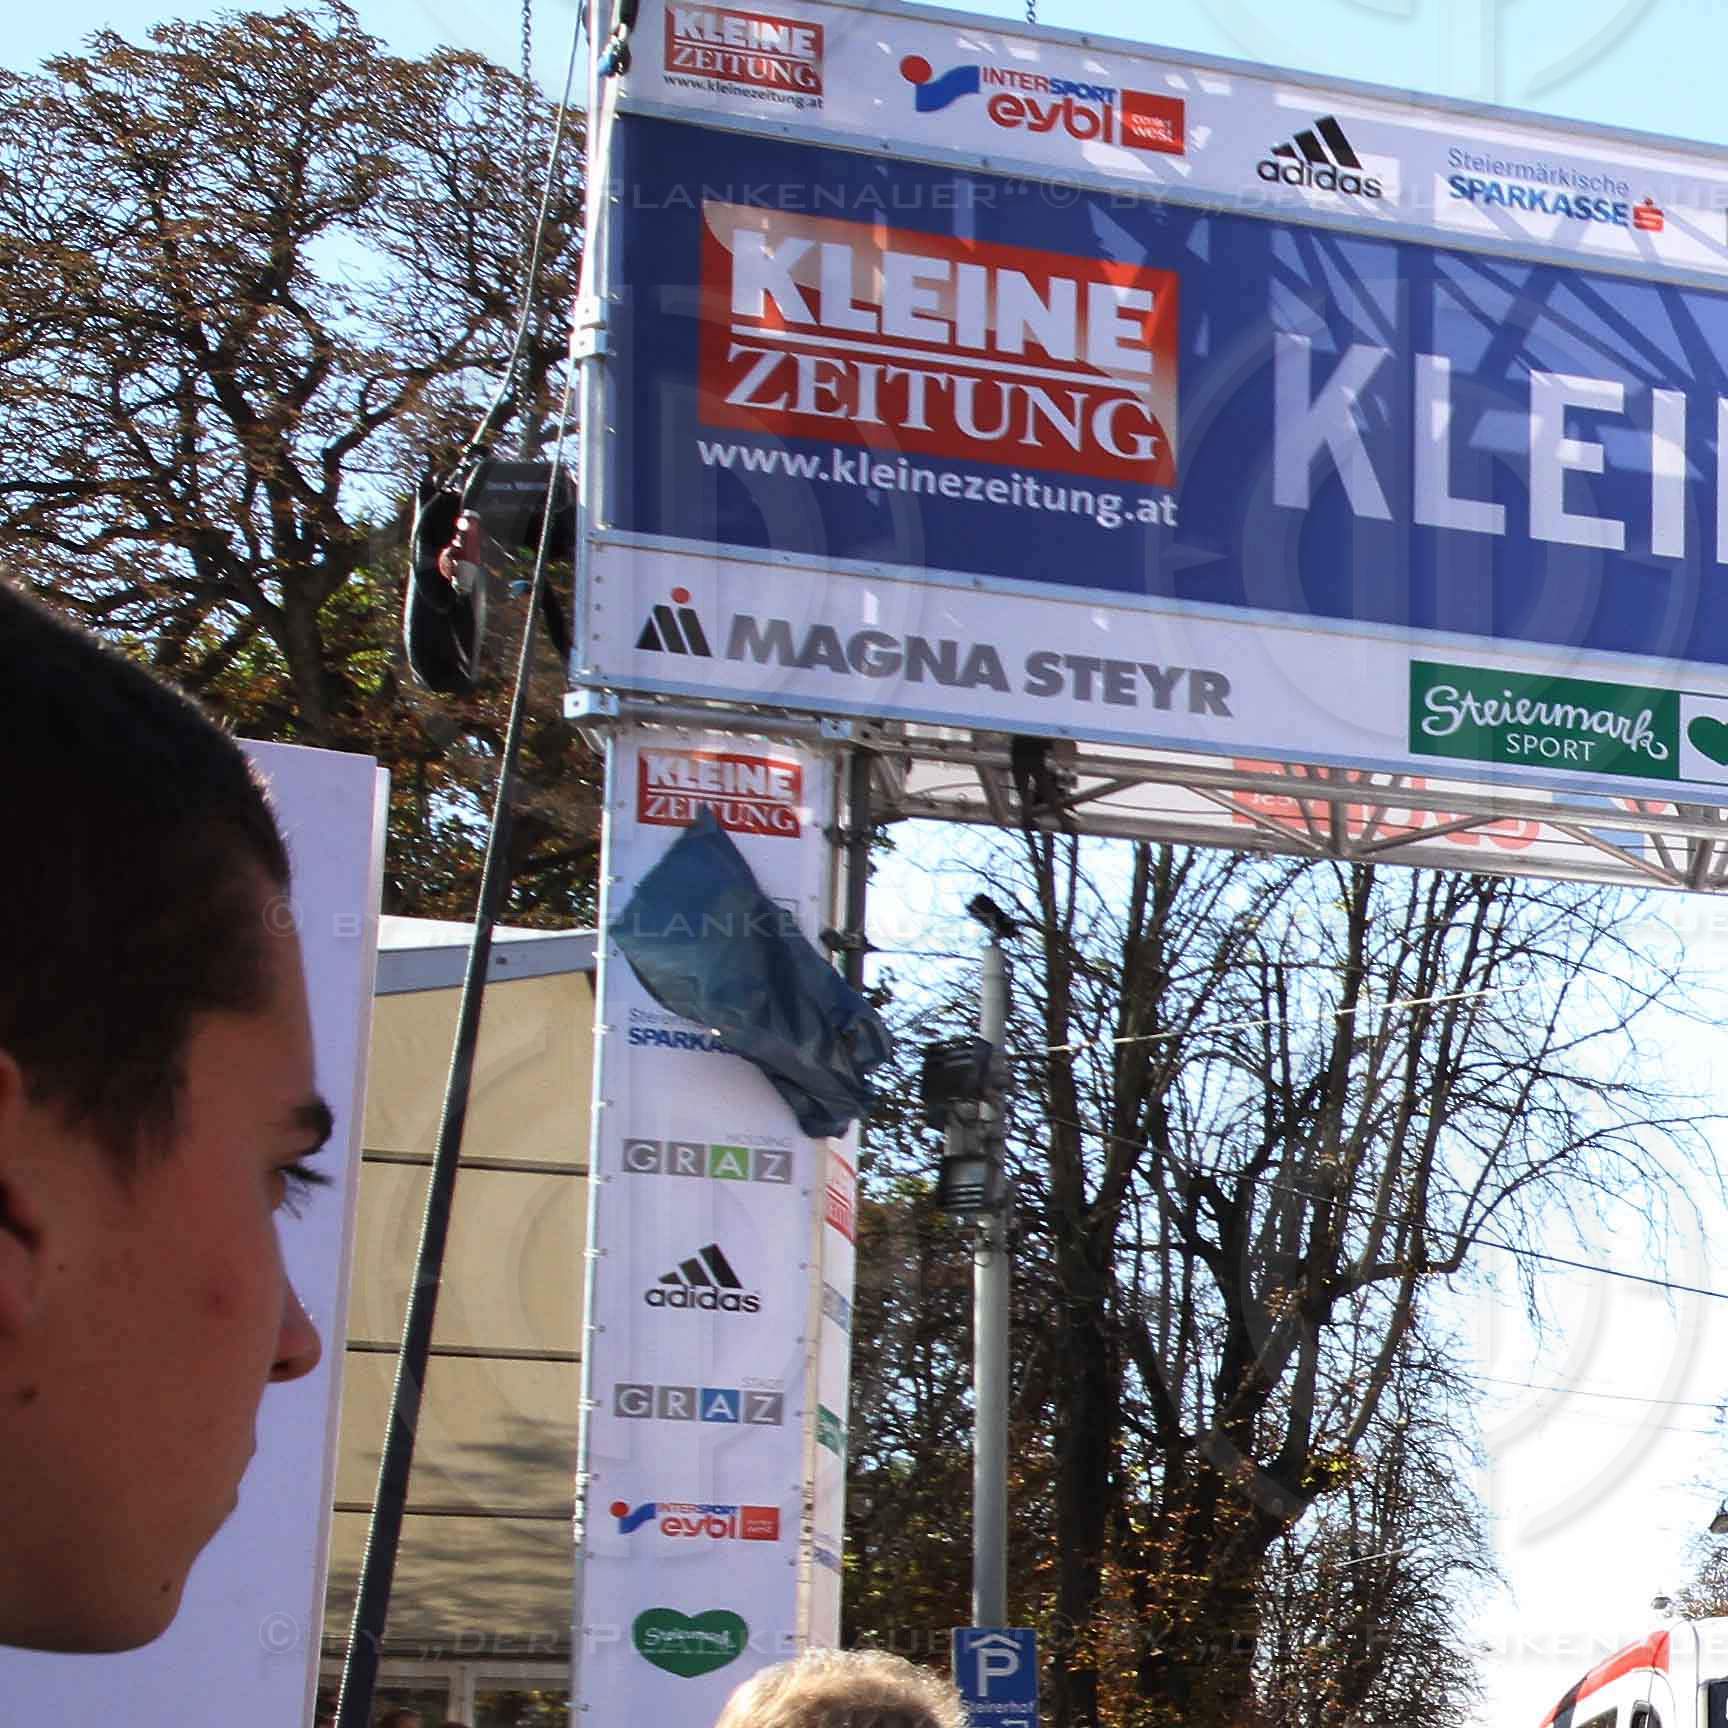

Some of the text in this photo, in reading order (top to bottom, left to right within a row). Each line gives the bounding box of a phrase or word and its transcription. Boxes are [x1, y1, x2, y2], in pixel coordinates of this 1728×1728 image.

[672, 7, 817, 57] KLEINE
[663, 72, 824, 110] www.kleinezeitung.at
[672, 47, 820, 91] ZEITUNG
[982, 65, 1119, 104] INTERSPORT
[986, 90, 1115, 144] eybl
[1257, 154, 1384, 201] adidas
[1447, 147, 1630, 198] Steiermärkische
[1447, 174, 1630, 232] SPARKASSE
[732, 227, 1153, 372] KLEINE
[724, 342, 1159, 462] ZEITUNG
[696, 440, 1179, 530] www.kleinezeitung.at
[726, 614, 1235, 718] MAGNA STEYR
[1421, 683, 1670, 761] Steiermark
[1505, 731, 1595, 763] SPORT
[646, 754, 796, 799] KLEINE
[627, 1026, 724, 1054] SPARKA
[627, 1143, 786, 1183] GRAZ
[643, 1285, 762, 1315] adidas
[618, 1388, 776, 1425] GRAZ
[659, 1514, 736, 1539] eybl
[977, 1648, 1019, 1697] P
